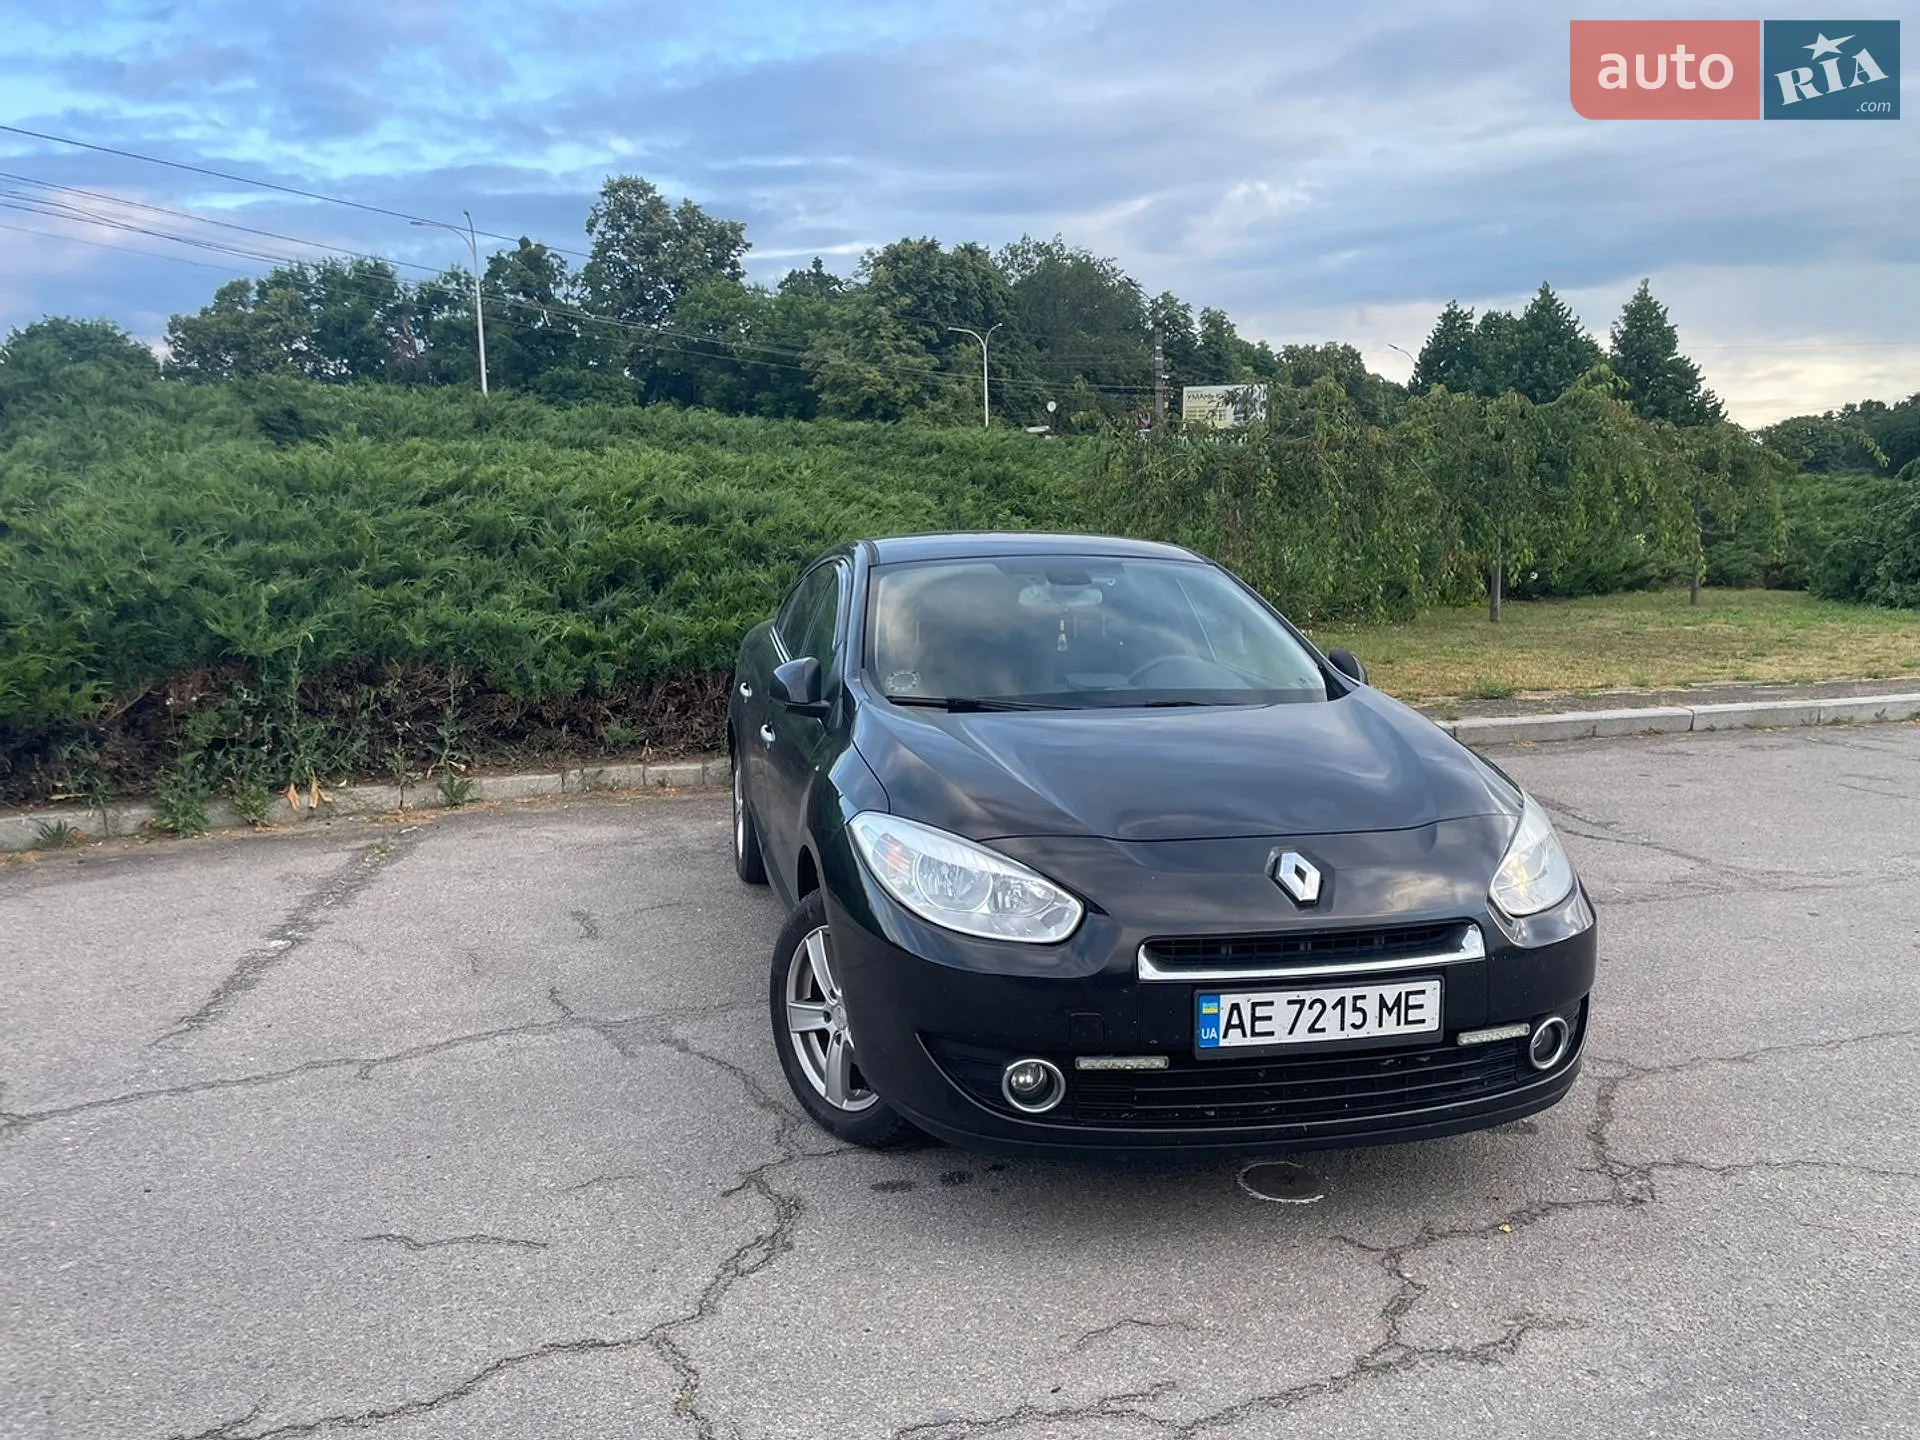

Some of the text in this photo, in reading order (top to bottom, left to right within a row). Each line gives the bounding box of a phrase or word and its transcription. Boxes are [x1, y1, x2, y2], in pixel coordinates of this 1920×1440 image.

[1222, 989, 1427, 1039] AE 7215 ME
[1201, 1027, 1218, 1040] UA
